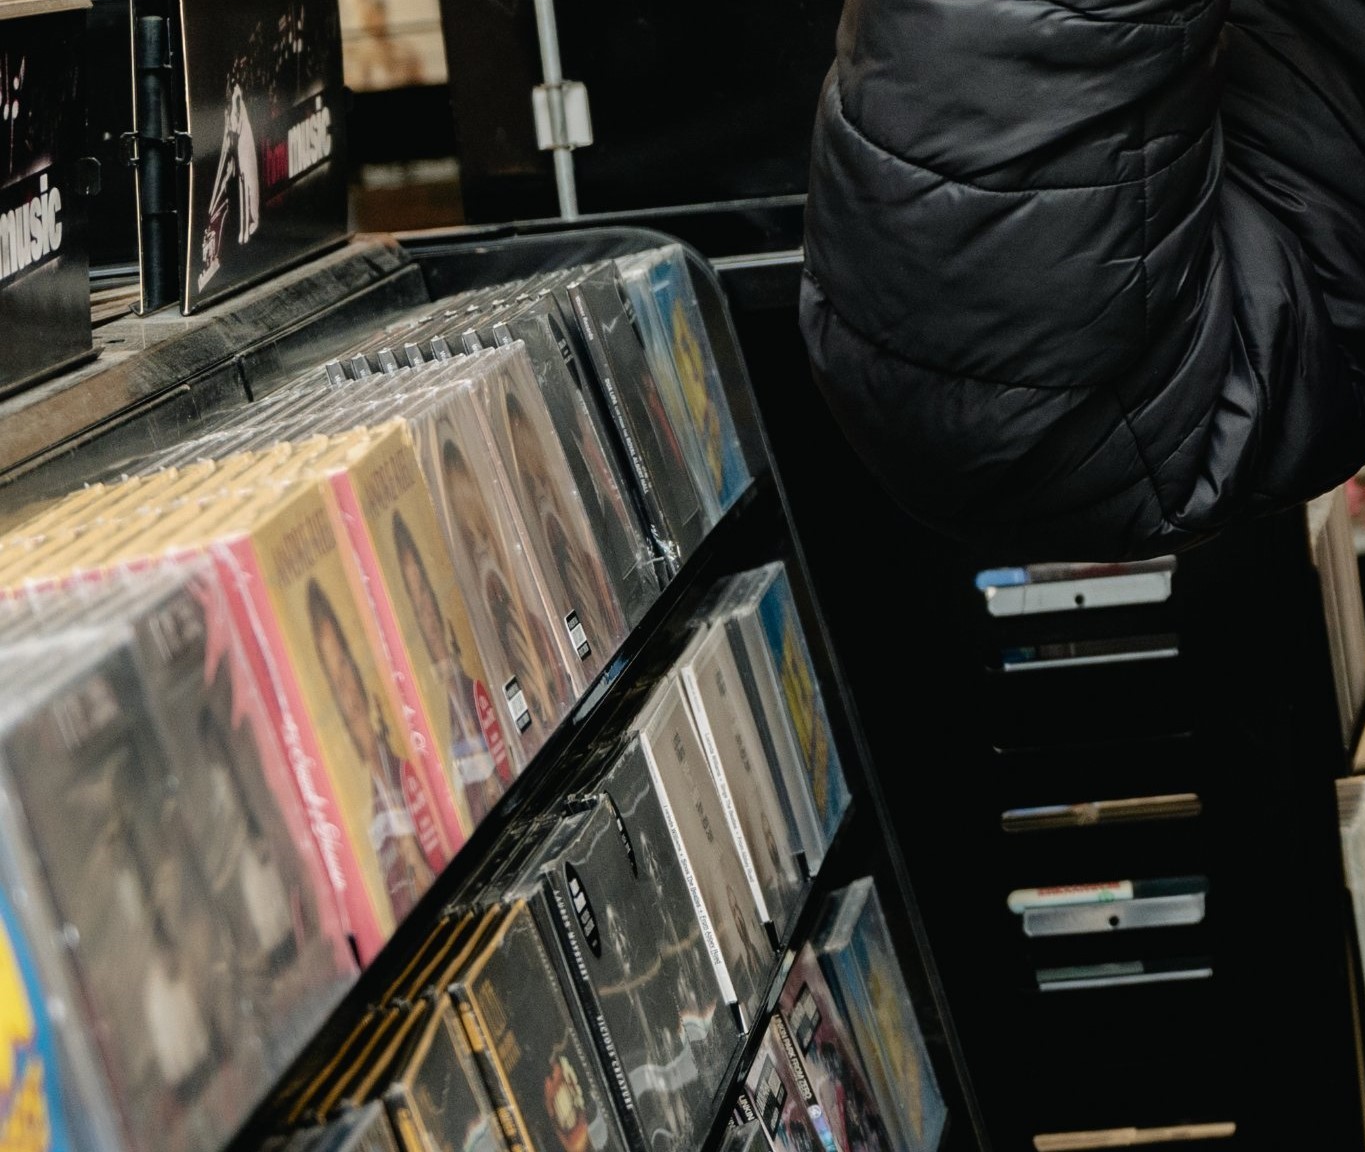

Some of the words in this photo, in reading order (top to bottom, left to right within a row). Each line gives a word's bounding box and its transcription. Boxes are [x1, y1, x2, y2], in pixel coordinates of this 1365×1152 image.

[0, 173, 62, 280] music
[594, 1014, 617, 1057] VICIOUS
[771, 1013, 788, 1039] LINKIN
[781, 1037, 797, 1058] PARK
[789, 1056, 805, 1080] FROM
[796, 1078, 813, 1100] ZERO
[735, 1093, 757, 1121] LINKIN
